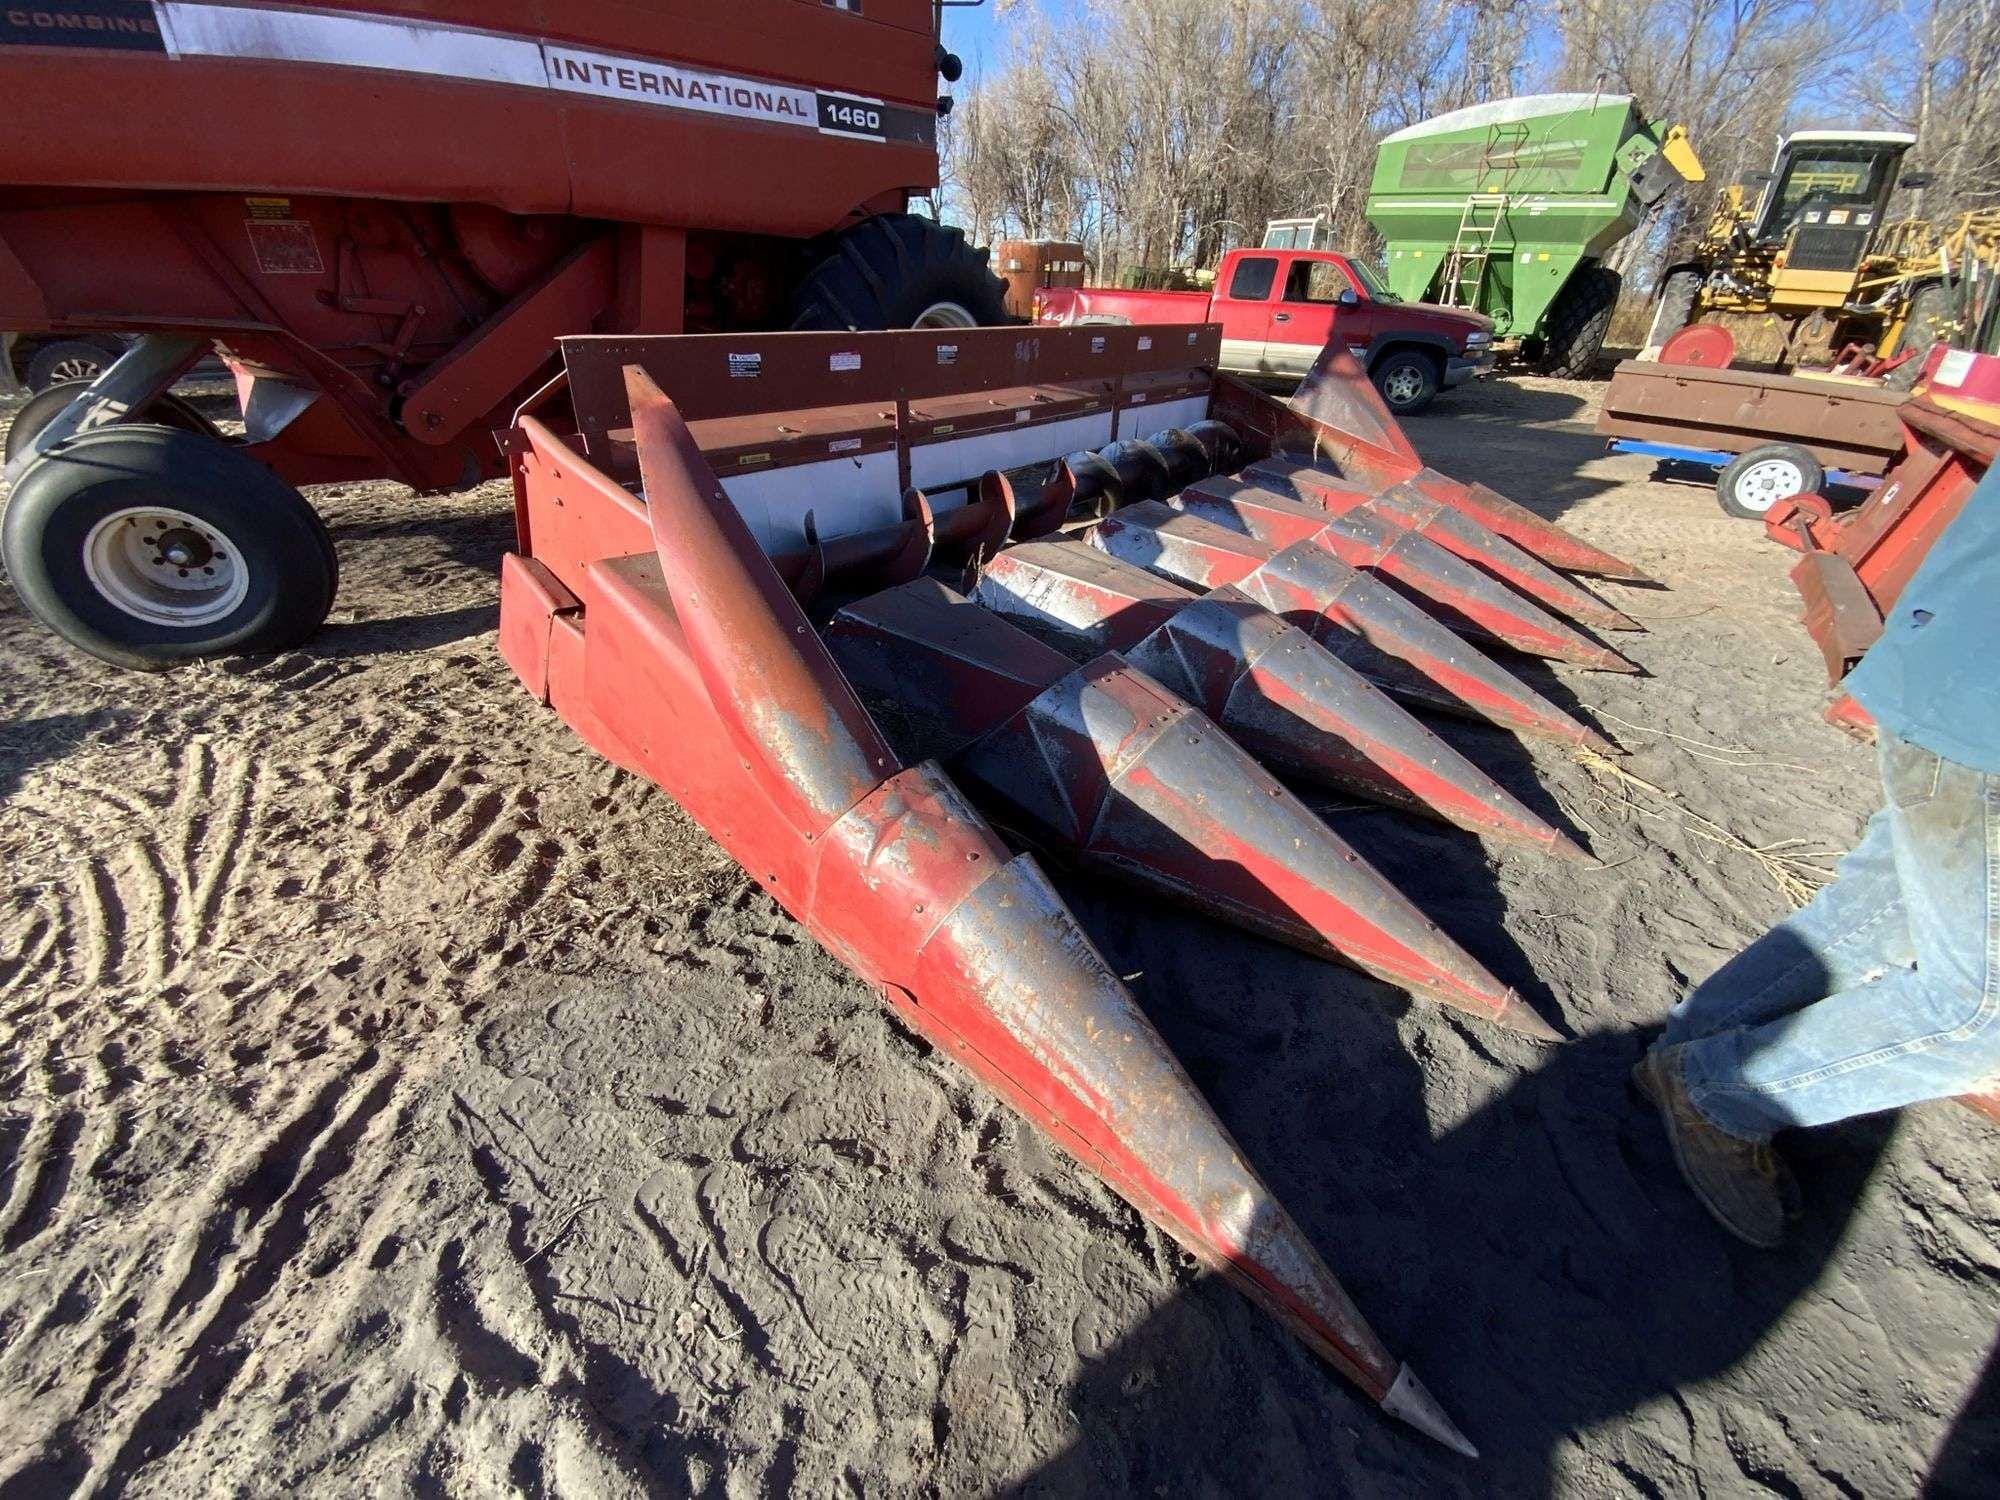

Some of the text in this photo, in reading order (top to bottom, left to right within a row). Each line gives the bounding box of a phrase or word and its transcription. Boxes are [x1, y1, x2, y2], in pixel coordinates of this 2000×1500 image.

[7, 10, 157, 33] COMBINE
[553, 57, 808, 117] INTERNATIONAL
[826, 103, 880, 129] 1460
